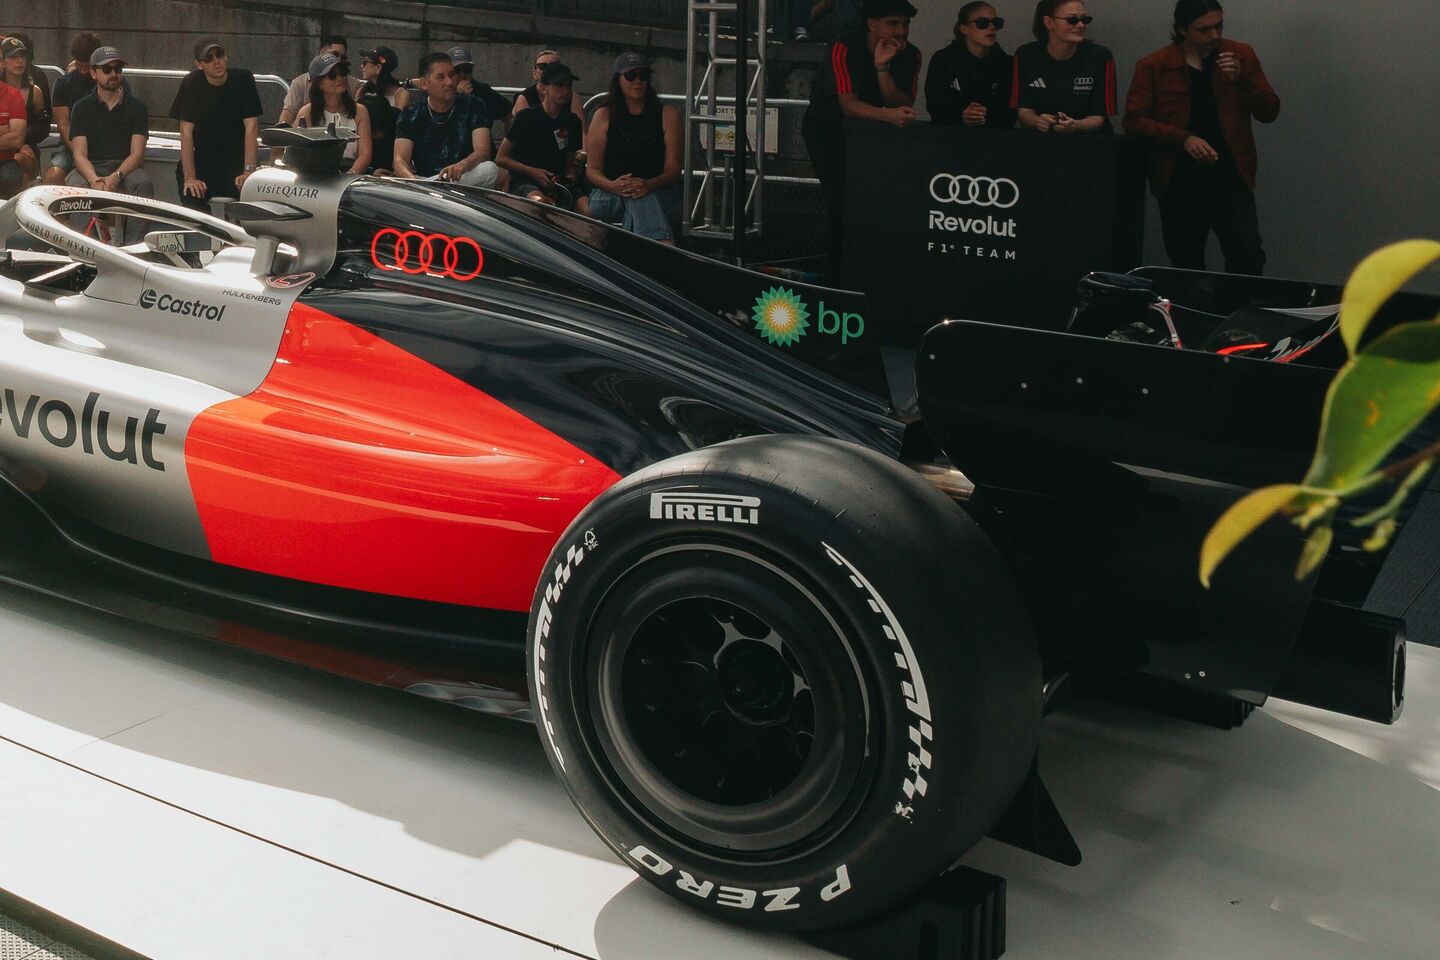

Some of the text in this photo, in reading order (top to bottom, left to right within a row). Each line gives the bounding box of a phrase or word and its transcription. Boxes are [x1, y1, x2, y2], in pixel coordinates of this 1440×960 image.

[257, 183, 319, 199] visitQATAR
[60, 199, 93, 213] Revolut
[929, 210, 1017, 238] Revolut
[53, 231, 65, 244] OF
[67, 239, 97, 258] HYATT
[963, 245, 1016, 260] TEAM
[157, 293, 226, 322] Castrol
[818, 301, 865, 345] bp
[650, 492, 761, 525] PIRELLI
[628, 844, 852, 912] P ZERO
